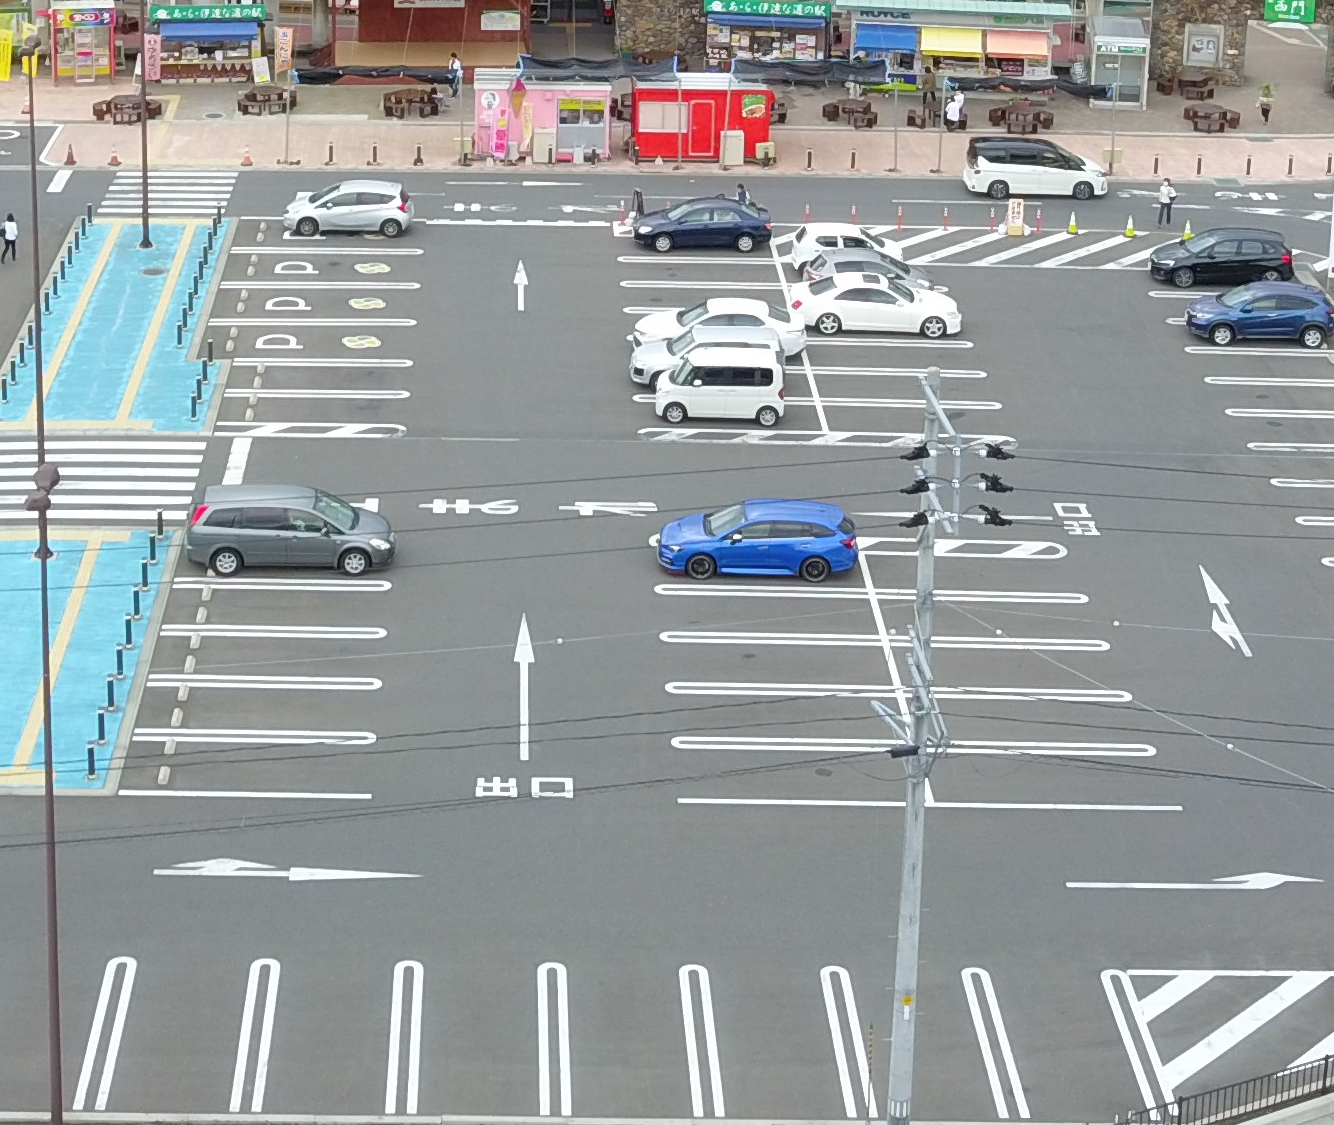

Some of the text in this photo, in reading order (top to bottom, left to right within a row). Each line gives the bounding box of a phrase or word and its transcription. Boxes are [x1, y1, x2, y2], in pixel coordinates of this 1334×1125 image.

[1274, 0, 1305, 16] 西門
[273, 261, 320, 274] P
[264, 296, 312, 310] P
[254, 333, 304, 349] P
[1052, 501, 1101, 537] 出口
[475, 775, 575, 799] 出口
